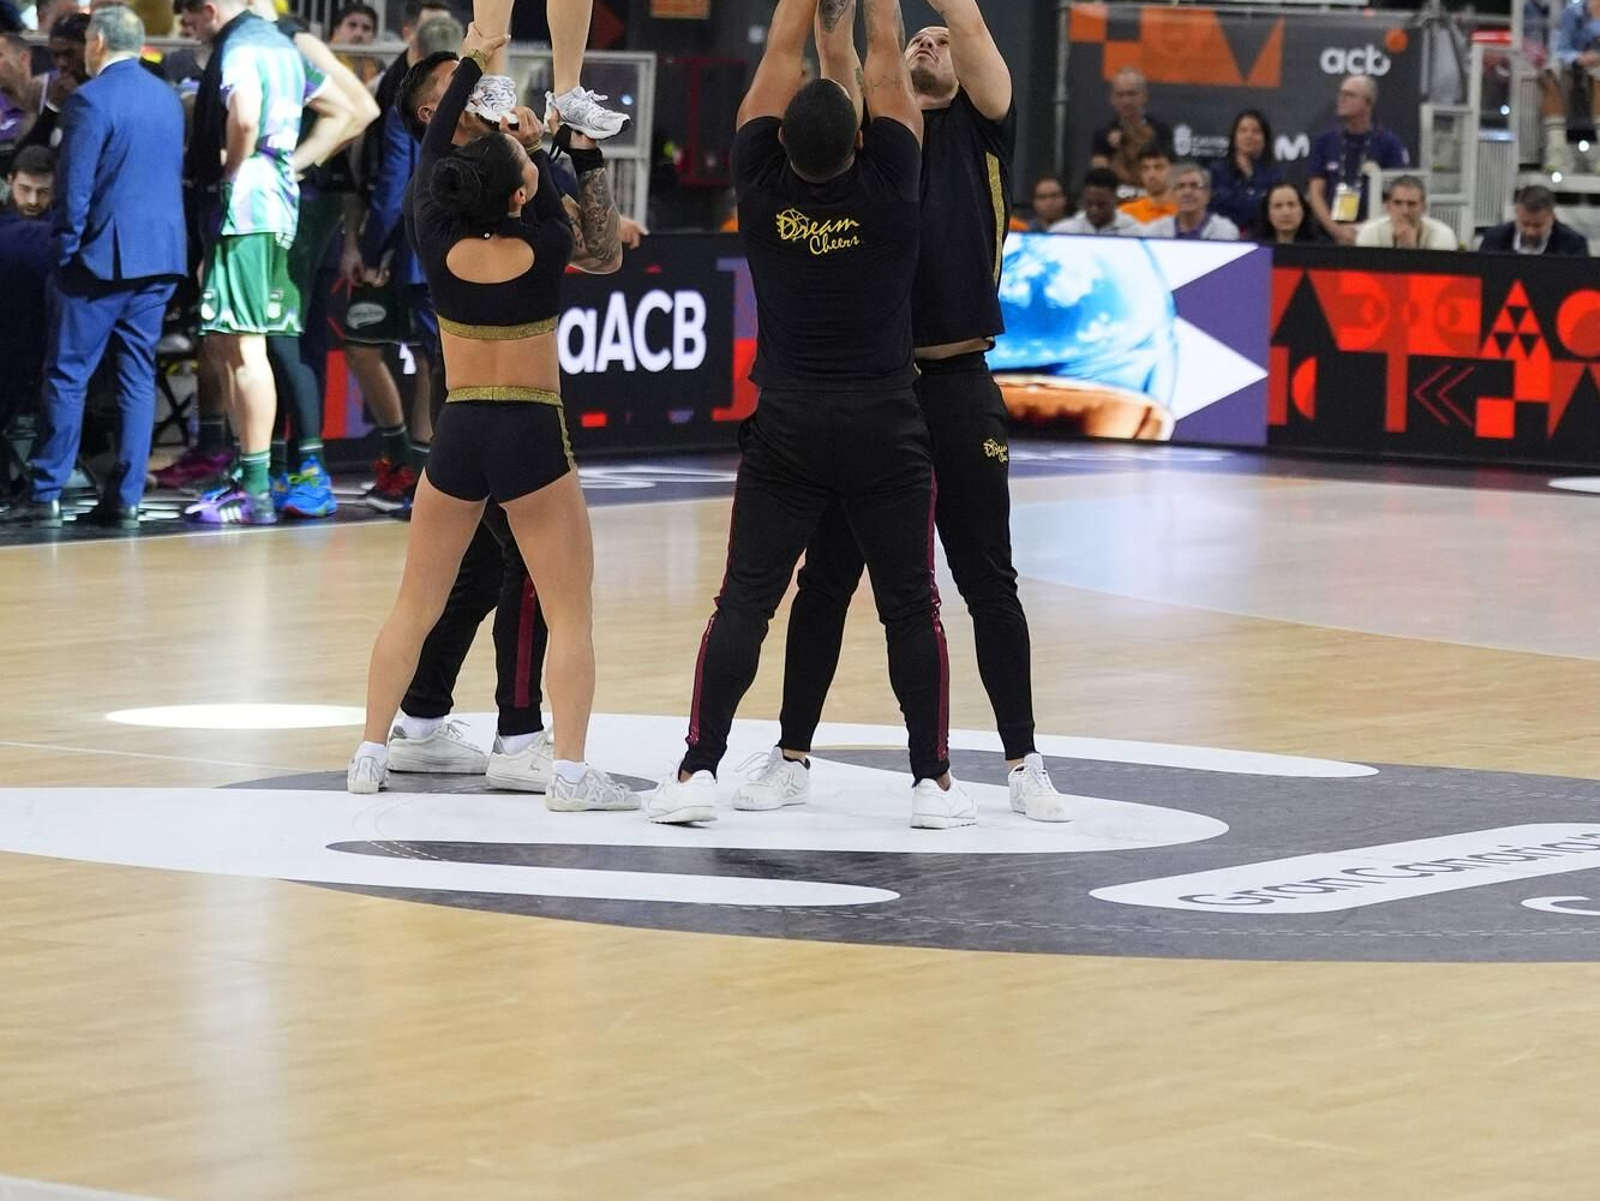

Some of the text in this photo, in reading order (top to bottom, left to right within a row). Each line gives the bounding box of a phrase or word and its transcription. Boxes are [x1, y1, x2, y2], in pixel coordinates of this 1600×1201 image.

[1320, 43, 1391, 76] acb
[776, 208, 860, 241] Dream
[809, 233, 860, 255] Cheers
[557, 289, 707, 375] aACB
[1178, 877, 1386, 907] Gran
